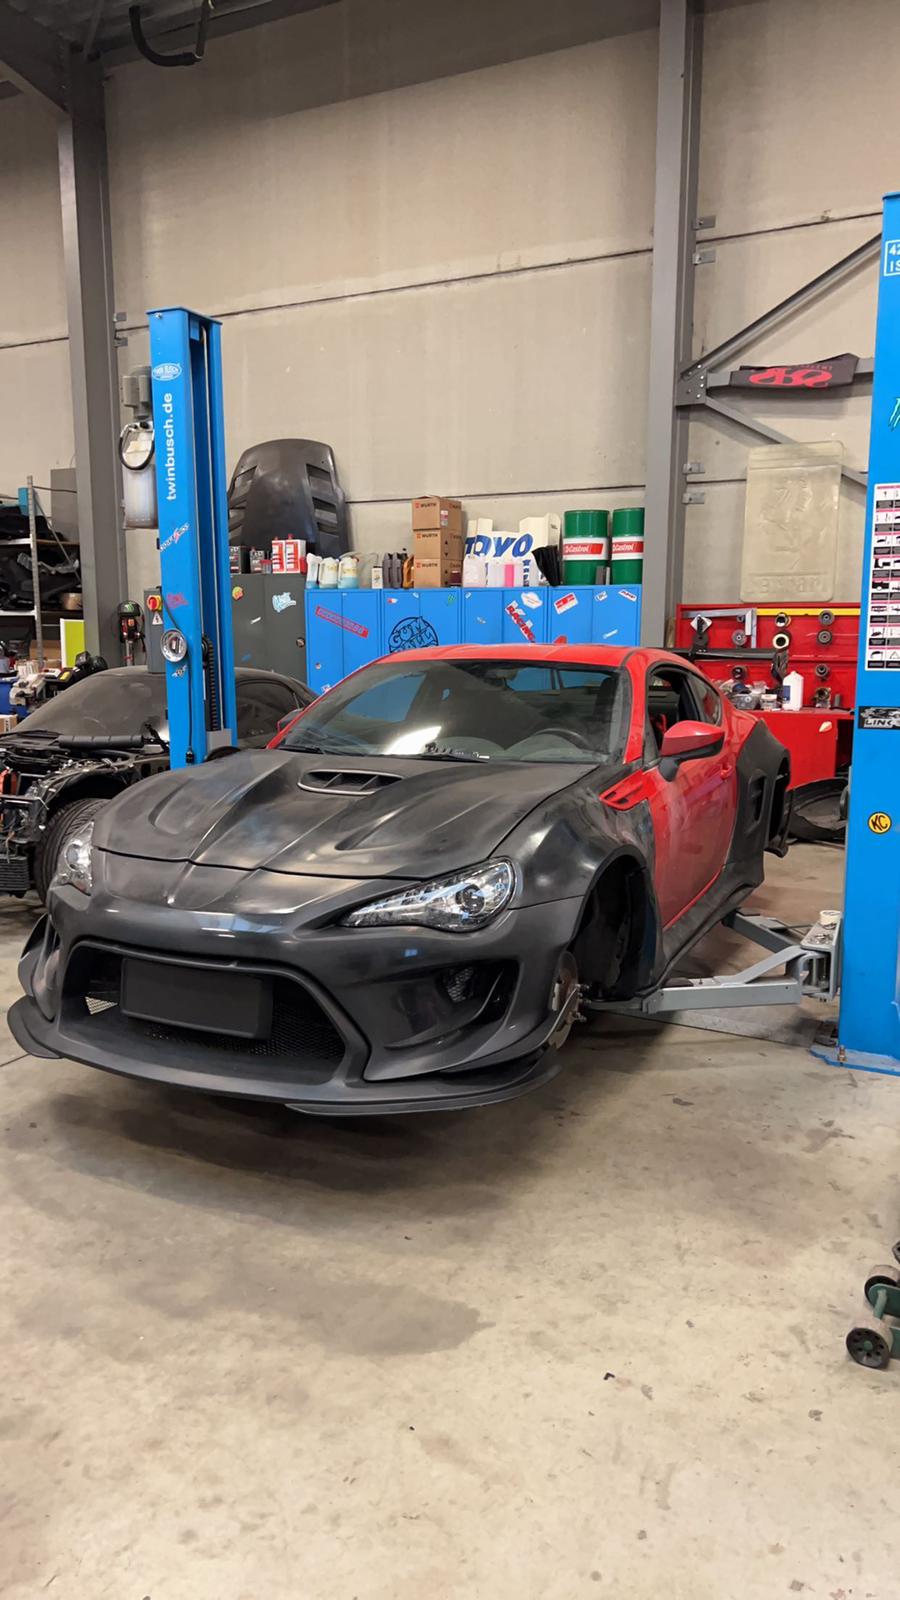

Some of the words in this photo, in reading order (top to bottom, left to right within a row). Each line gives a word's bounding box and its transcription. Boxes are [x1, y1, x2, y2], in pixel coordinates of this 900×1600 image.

[162, 392, 177, 500] twinbusch.de
[465, 533, 533, 557] TOYO
[870, 814, 888, 831] KC
